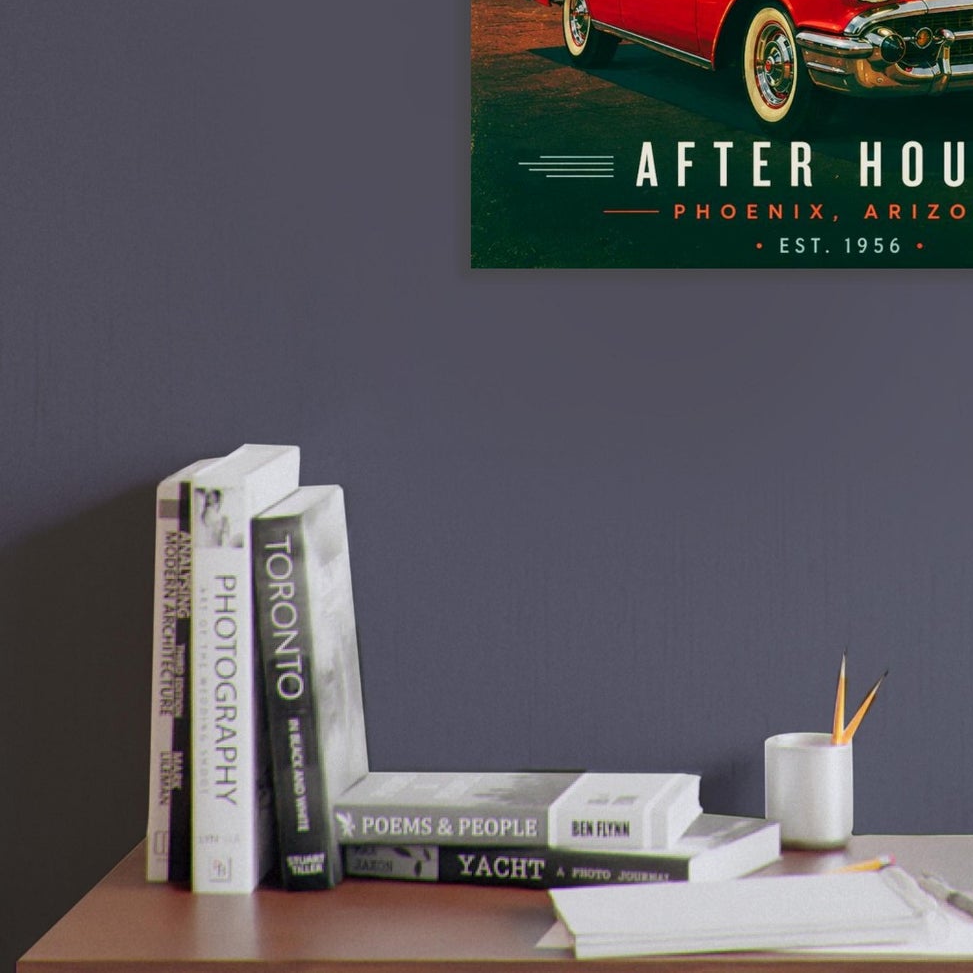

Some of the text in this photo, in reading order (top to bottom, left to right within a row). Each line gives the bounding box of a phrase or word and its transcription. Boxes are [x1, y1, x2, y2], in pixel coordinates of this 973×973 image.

[636, 140, 814, 188] AFTER
[673, 203, 839, 222] PHOENIX,
[779, 237, 902, 255] EST. 1956
[176, 530, 192, 619] ANALYSING
[159, 530, 178, 717] MODERN ARCHITECTURE
[264, 534, 304, 702] TORONTO
[214, 574, 238, 806] PHOTOGRAPHY
[362, 816, 537, 837] POEMS & PEOPLE
[571, 820, 630, 837] BEN FLYNN
[457, 853, 546, 880] YACHT
[556, 866, 565, 877] A
[572, 866, 612, 880] PHOTO
